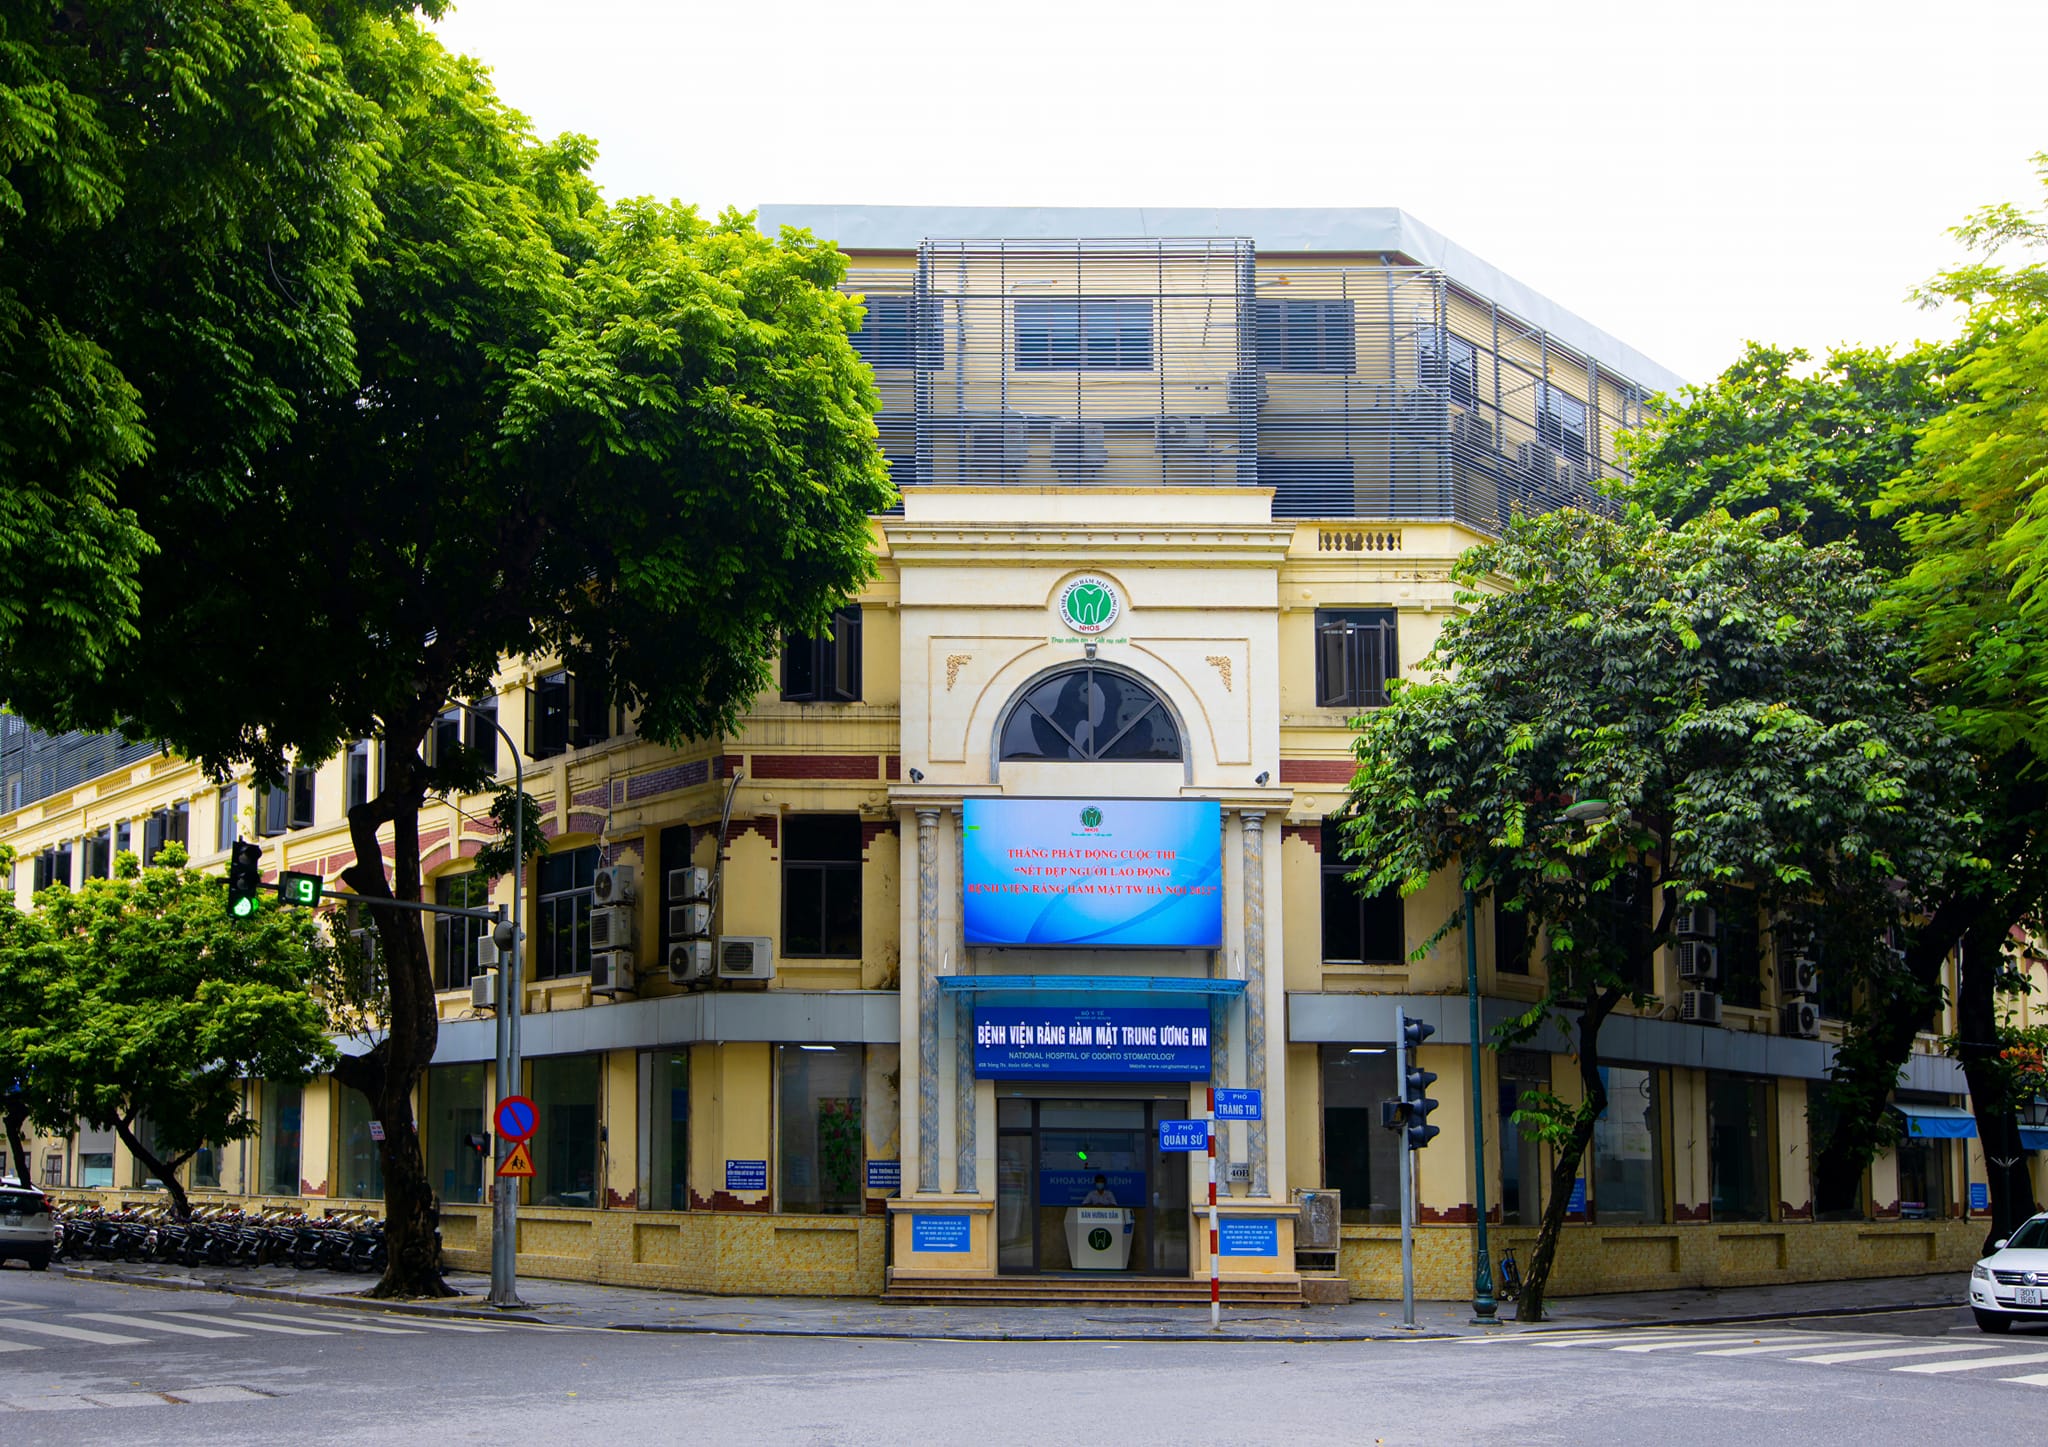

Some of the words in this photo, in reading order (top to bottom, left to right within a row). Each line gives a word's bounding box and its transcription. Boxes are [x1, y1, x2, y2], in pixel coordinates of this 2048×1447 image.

[1007, 848, 1048, 859] THÁNG
[1051, 848, 1082, 859] PHÁT
[1084, 849, 1118, 861] ĐỘNG
[1120, 849, 1153, 861] CUỘC
[1156, 850, 1176, 859] THI
[1045, 866, 1067, 878] ĐẸP
[1069, 865, 1107, 877] NGƯỜI
[1110, 867, 1135, 877] LAO
[1137, 867, 1171, 878] ĐỘNG
[299, 879, 313, 902] 9
[968, 884, 999, 895] BỆNH
[1002, 883, 1029, 895] VIỆN
[1032, 882, 1064, 894] RĂNG
[1098, 884, 1123, 896] MẶT
[1125, 885, 1144, 894] TW
[1147, 883, 1162, 895] HÀ
[1166, 885, 1187, 896] NỘI
[978, 1020, 1006, 1048] BỆNH
[1009, 1020, 1034, 1048] VIỆN
[1036, 1021, 1066, 1045] RĂNG
[1068, 1021, 1093, 1045] HÀM
[1096, 1021, 1118, 1049] MẶT
[1121, 1026, 1156, 1046] TRUNG
[1160, 1025, 1189, 1046] ƯƠNG
[1191, 1027, 1207, 1046] HN
[1009, 1052, 1044, 1060] NATIONAL
[1045, 1052, 1079, 1060] HOSPITAL
[1080, 1052, 1090, 1060] OF
[1091, 1053, 1121, 1061] ODONTO
[1123, 1053, 1176, 1061] STOMATOLOGY
[1218, 1102, 1243, 1116] TRÀNG
[1245, 1104, 1257, 1115] THI
[1163, 1133, 1188, 1146] QUÁN
[1191, 1132, 1204, 1145] SỨ
[1049, 1176, 1076, 1185] KHOA
[1078, 1175, 1096, 1185] KHÁ
[2020, 1288, 2035, 1297] 30Y
